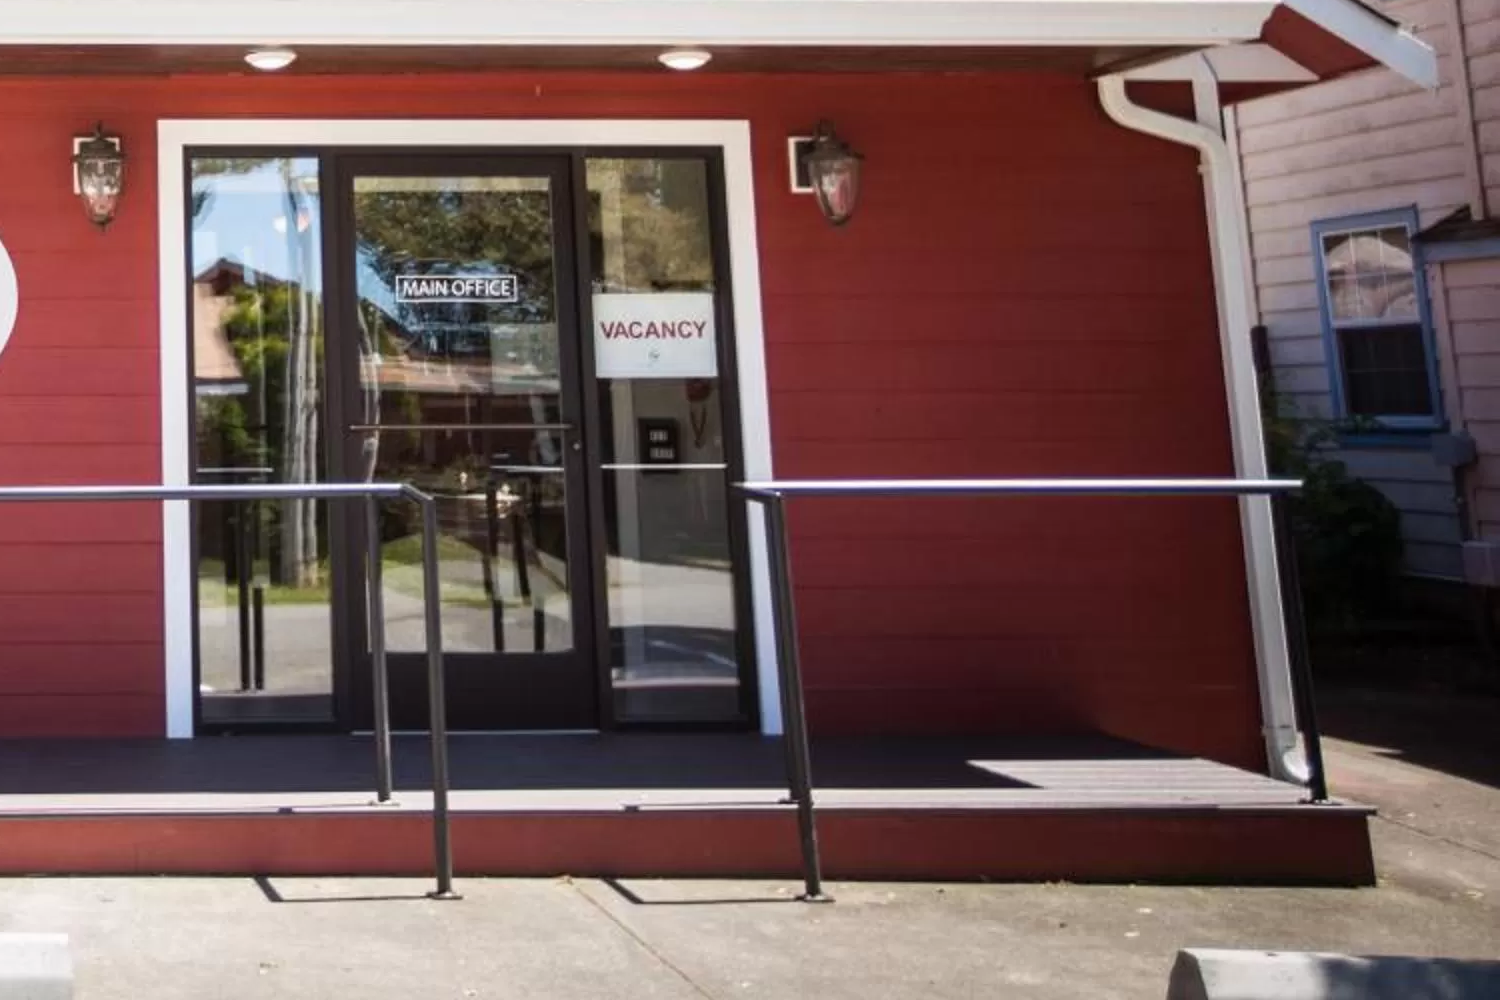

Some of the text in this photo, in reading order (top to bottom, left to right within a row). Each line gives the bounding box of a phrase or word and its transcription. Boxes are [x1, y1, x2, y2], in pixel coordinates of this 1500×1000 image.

[403, 280, 511, 297] MAIN OFFICE
[600, 321, 706, 339] VACANCY
